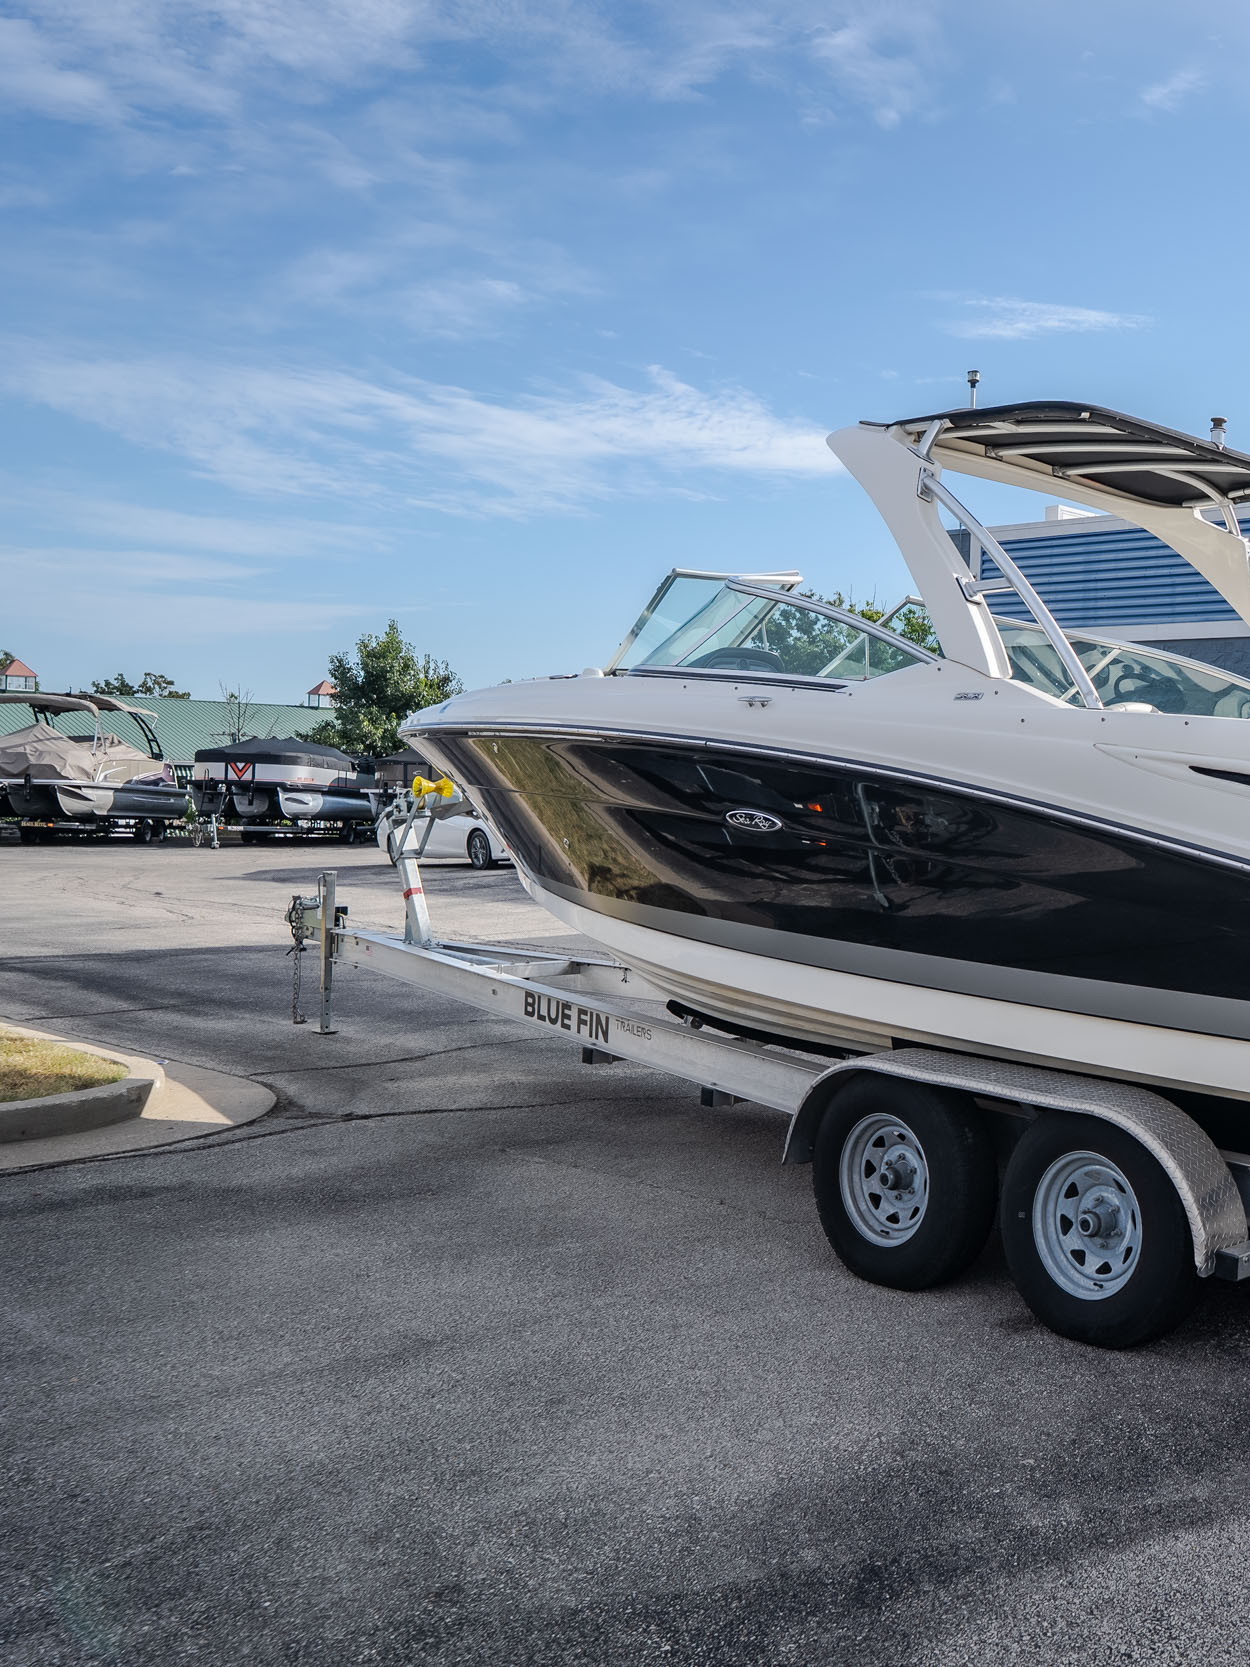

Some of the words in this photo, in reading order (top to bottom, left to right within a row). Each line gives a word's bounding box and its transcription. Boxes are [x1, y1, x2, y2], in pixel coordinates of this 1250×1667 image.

[732, 813, 751, 825] Sea
[752, 815, 772, 830] Ray
[524, 990, 573, 1032] BLUE
[576, 1007, 610, 1044] FIN
[615, 1018, 653, 1041] TRAILERS
